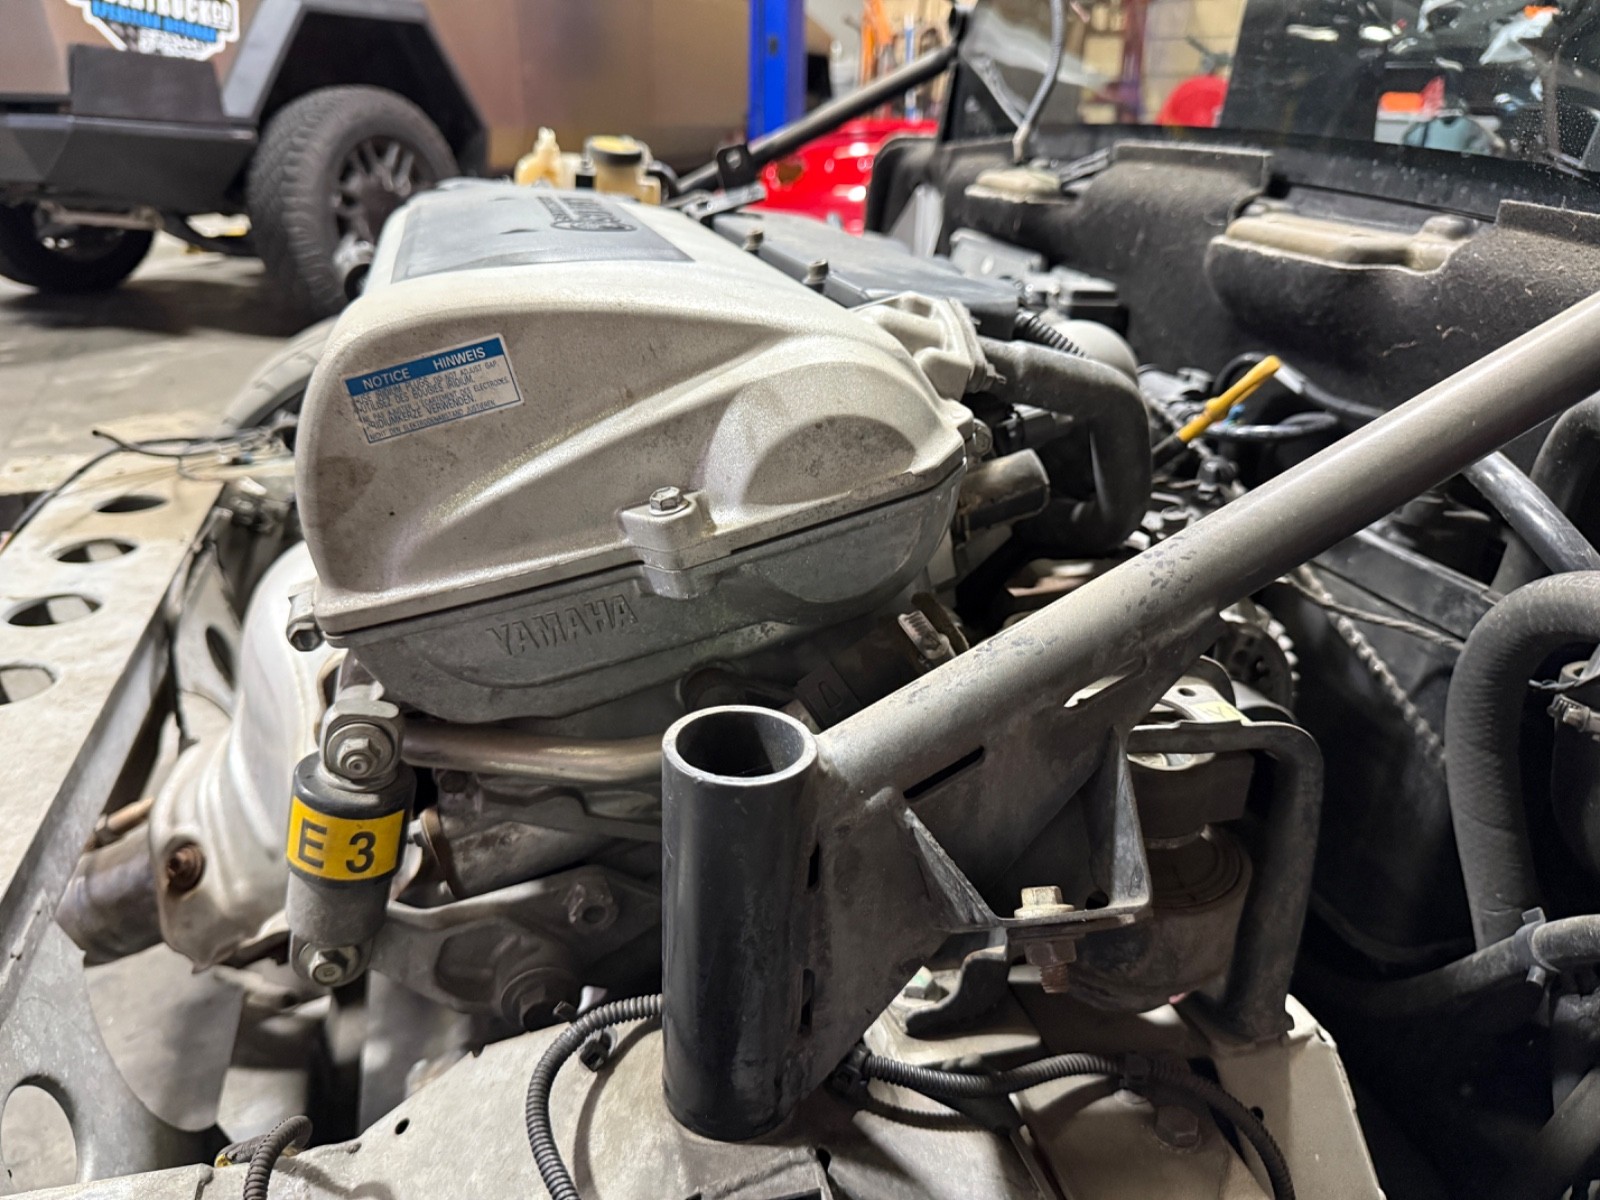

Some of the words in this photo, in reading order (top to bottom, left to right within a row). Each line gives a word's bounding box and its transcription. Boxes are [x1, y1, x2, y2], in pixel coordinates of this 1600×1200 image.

[362, 368, 411, 390] NOTICE
[432, 346, 486, 371] HINWEIS
[486, 594, 638, 656] YAMAHA
